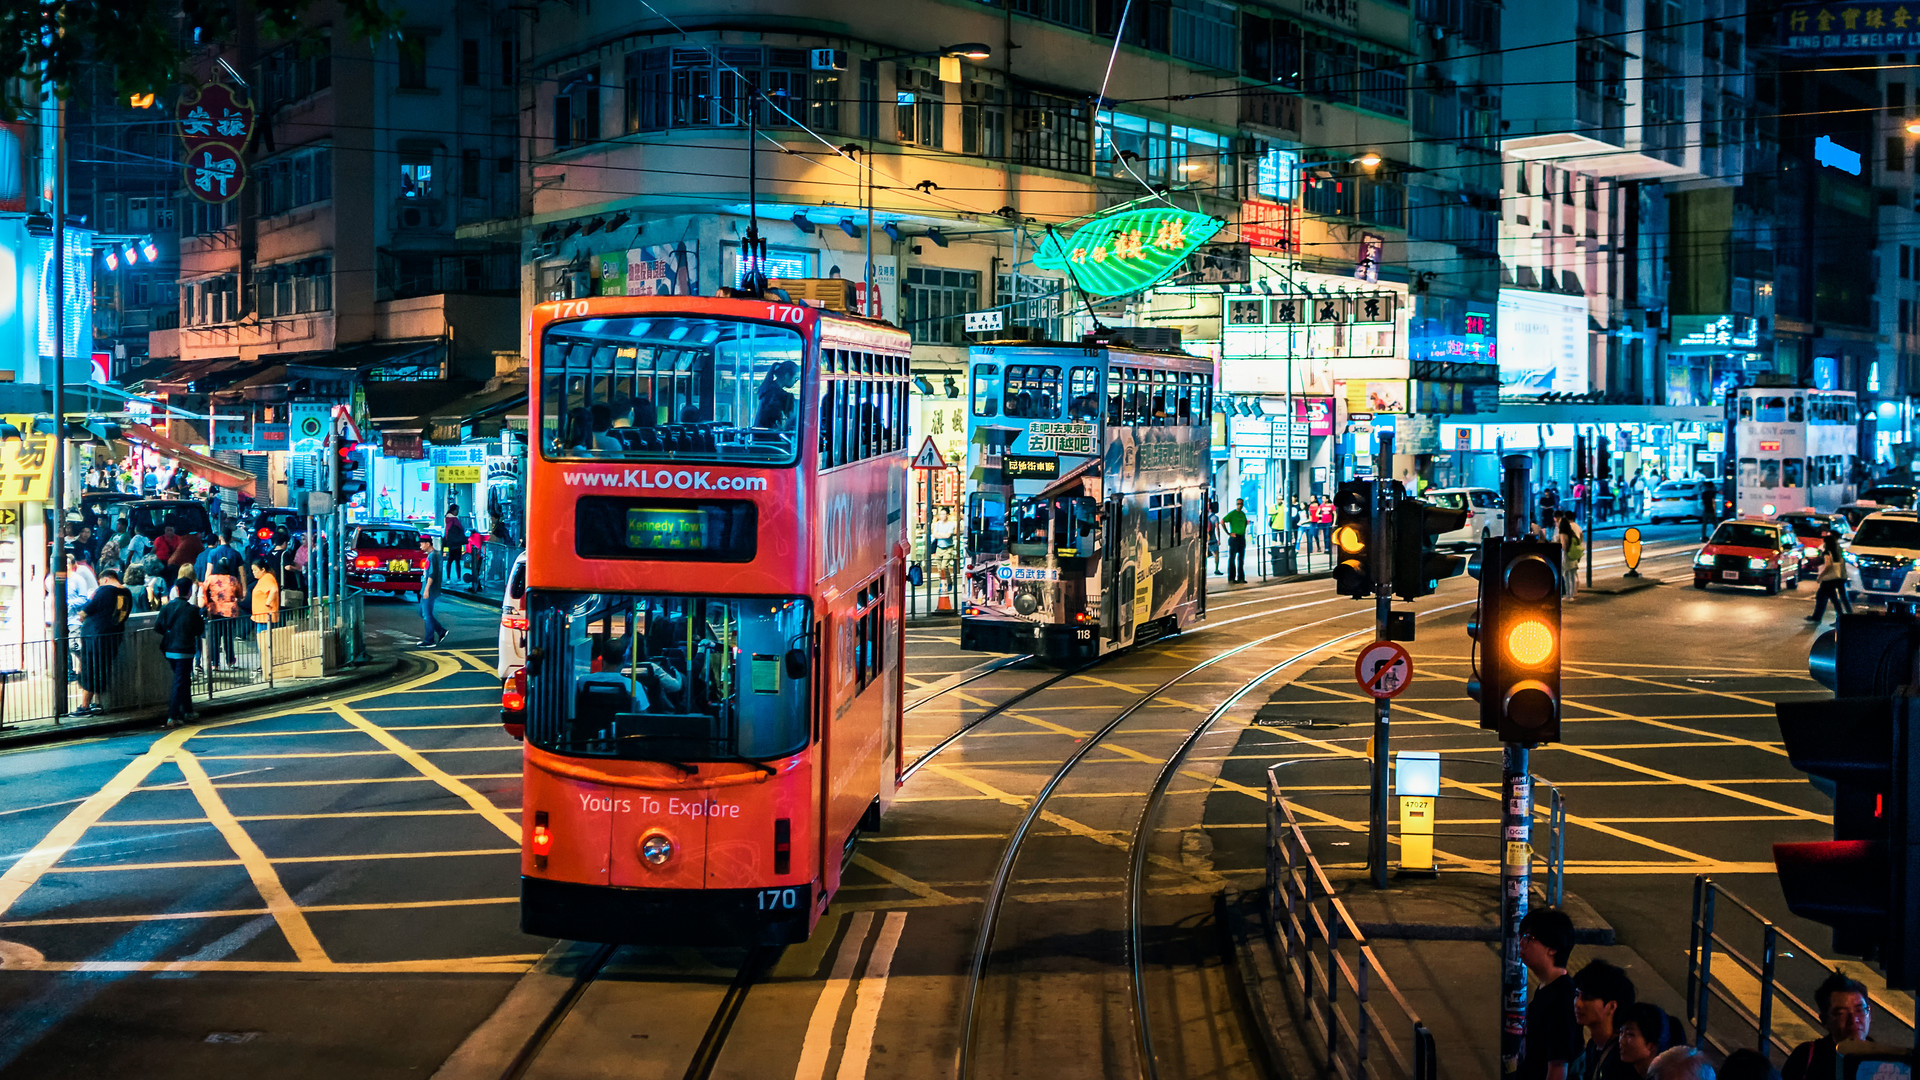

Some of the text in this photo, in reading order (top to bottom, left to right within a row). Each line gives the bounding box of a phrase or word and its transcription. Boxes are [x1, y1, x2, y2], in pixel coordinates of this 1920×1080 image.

[1823, 35, 1840, 47] ON
[1842, 33, 1904, 47] JEWELRY
[195, 151, 237, 196] 押
[552, 300, 589, 319] 170
[766, 304, 805, 324] 170
[981, 347, 996, 355] 118
[1082, 348, 1099, 358] 118
[563, 470, 767, 491] www.KLOOK.com
[629, 519, 705, 533] Kennedy Town
[1076, 629, 1091, 640] 118
[579, 794, 740, 820] Yours To Explore
[757, 889, 796, 910] 170
